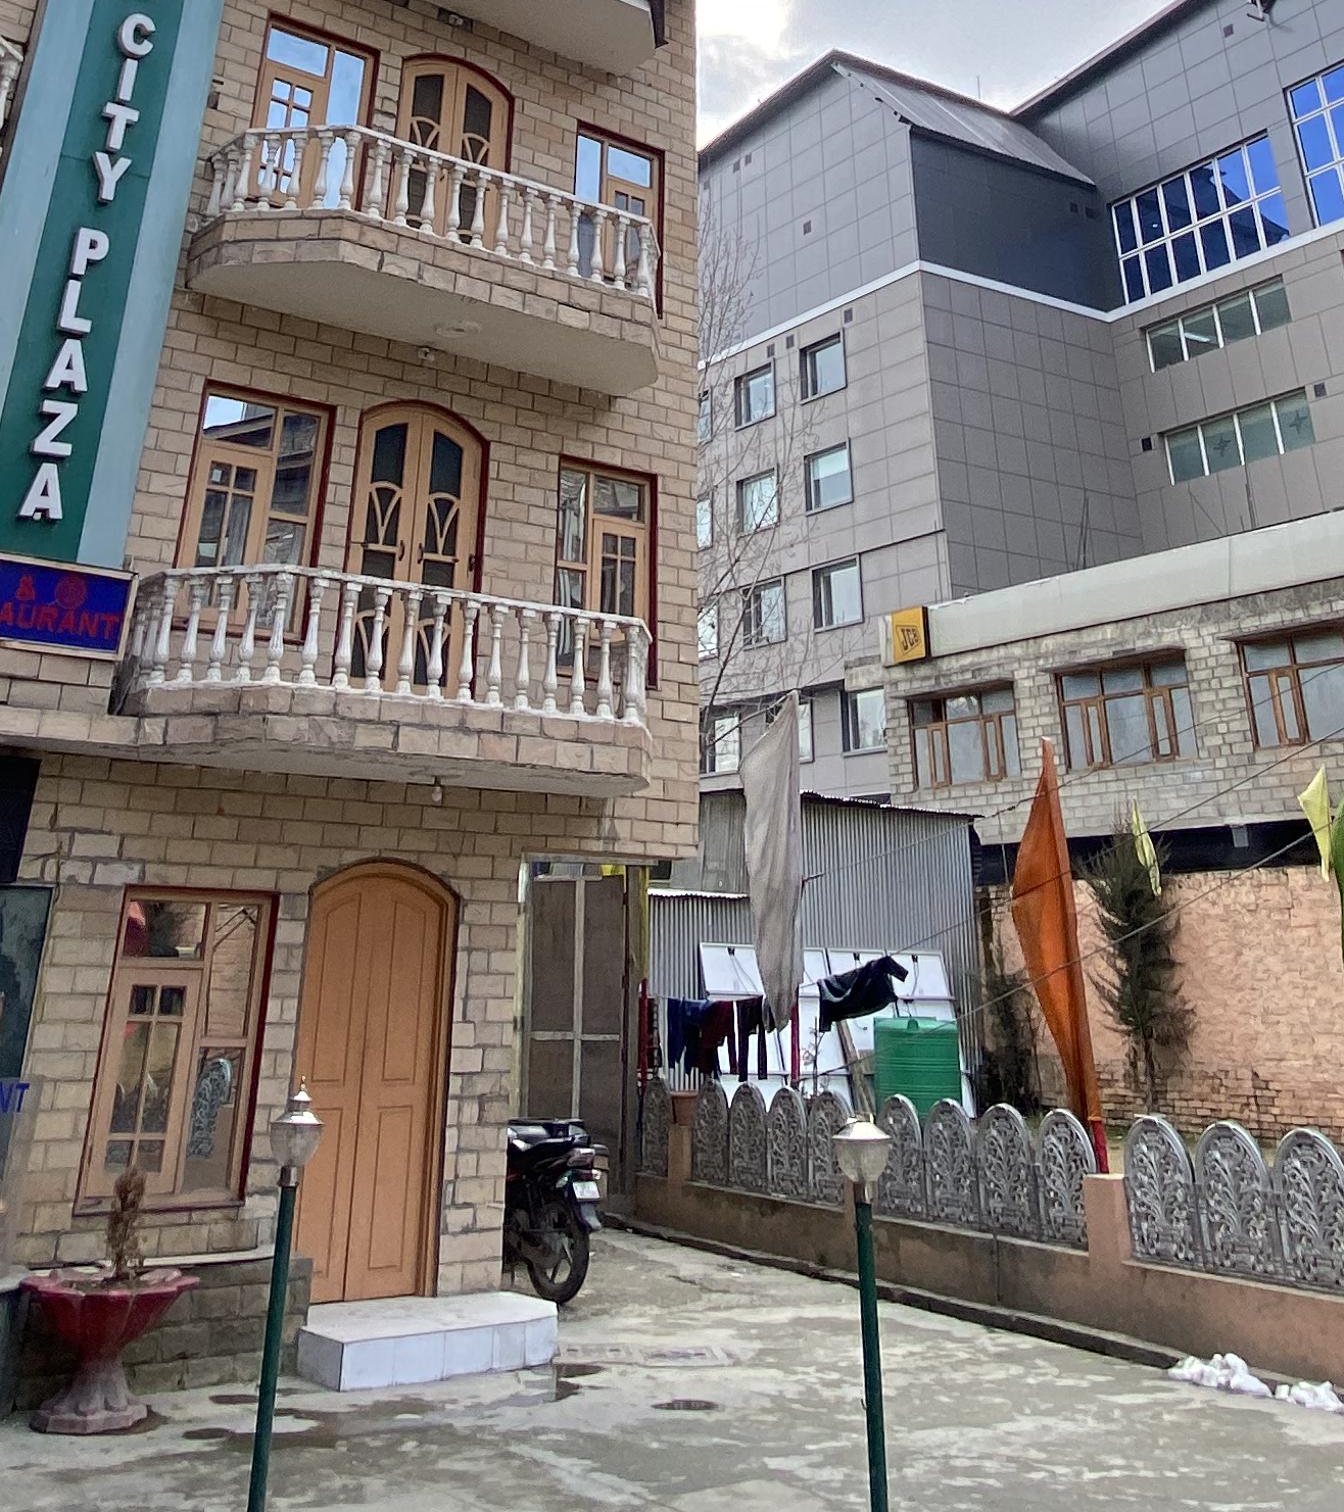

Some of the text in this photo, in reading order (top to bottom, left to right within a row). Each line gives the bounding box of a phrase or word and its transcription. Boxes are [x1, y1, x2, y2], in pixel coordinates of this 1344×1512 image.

[92, 13, 156, 203] CITY
[16, 226, 110, 520] PLAZA
[900, 628, 918, 651] JCB
